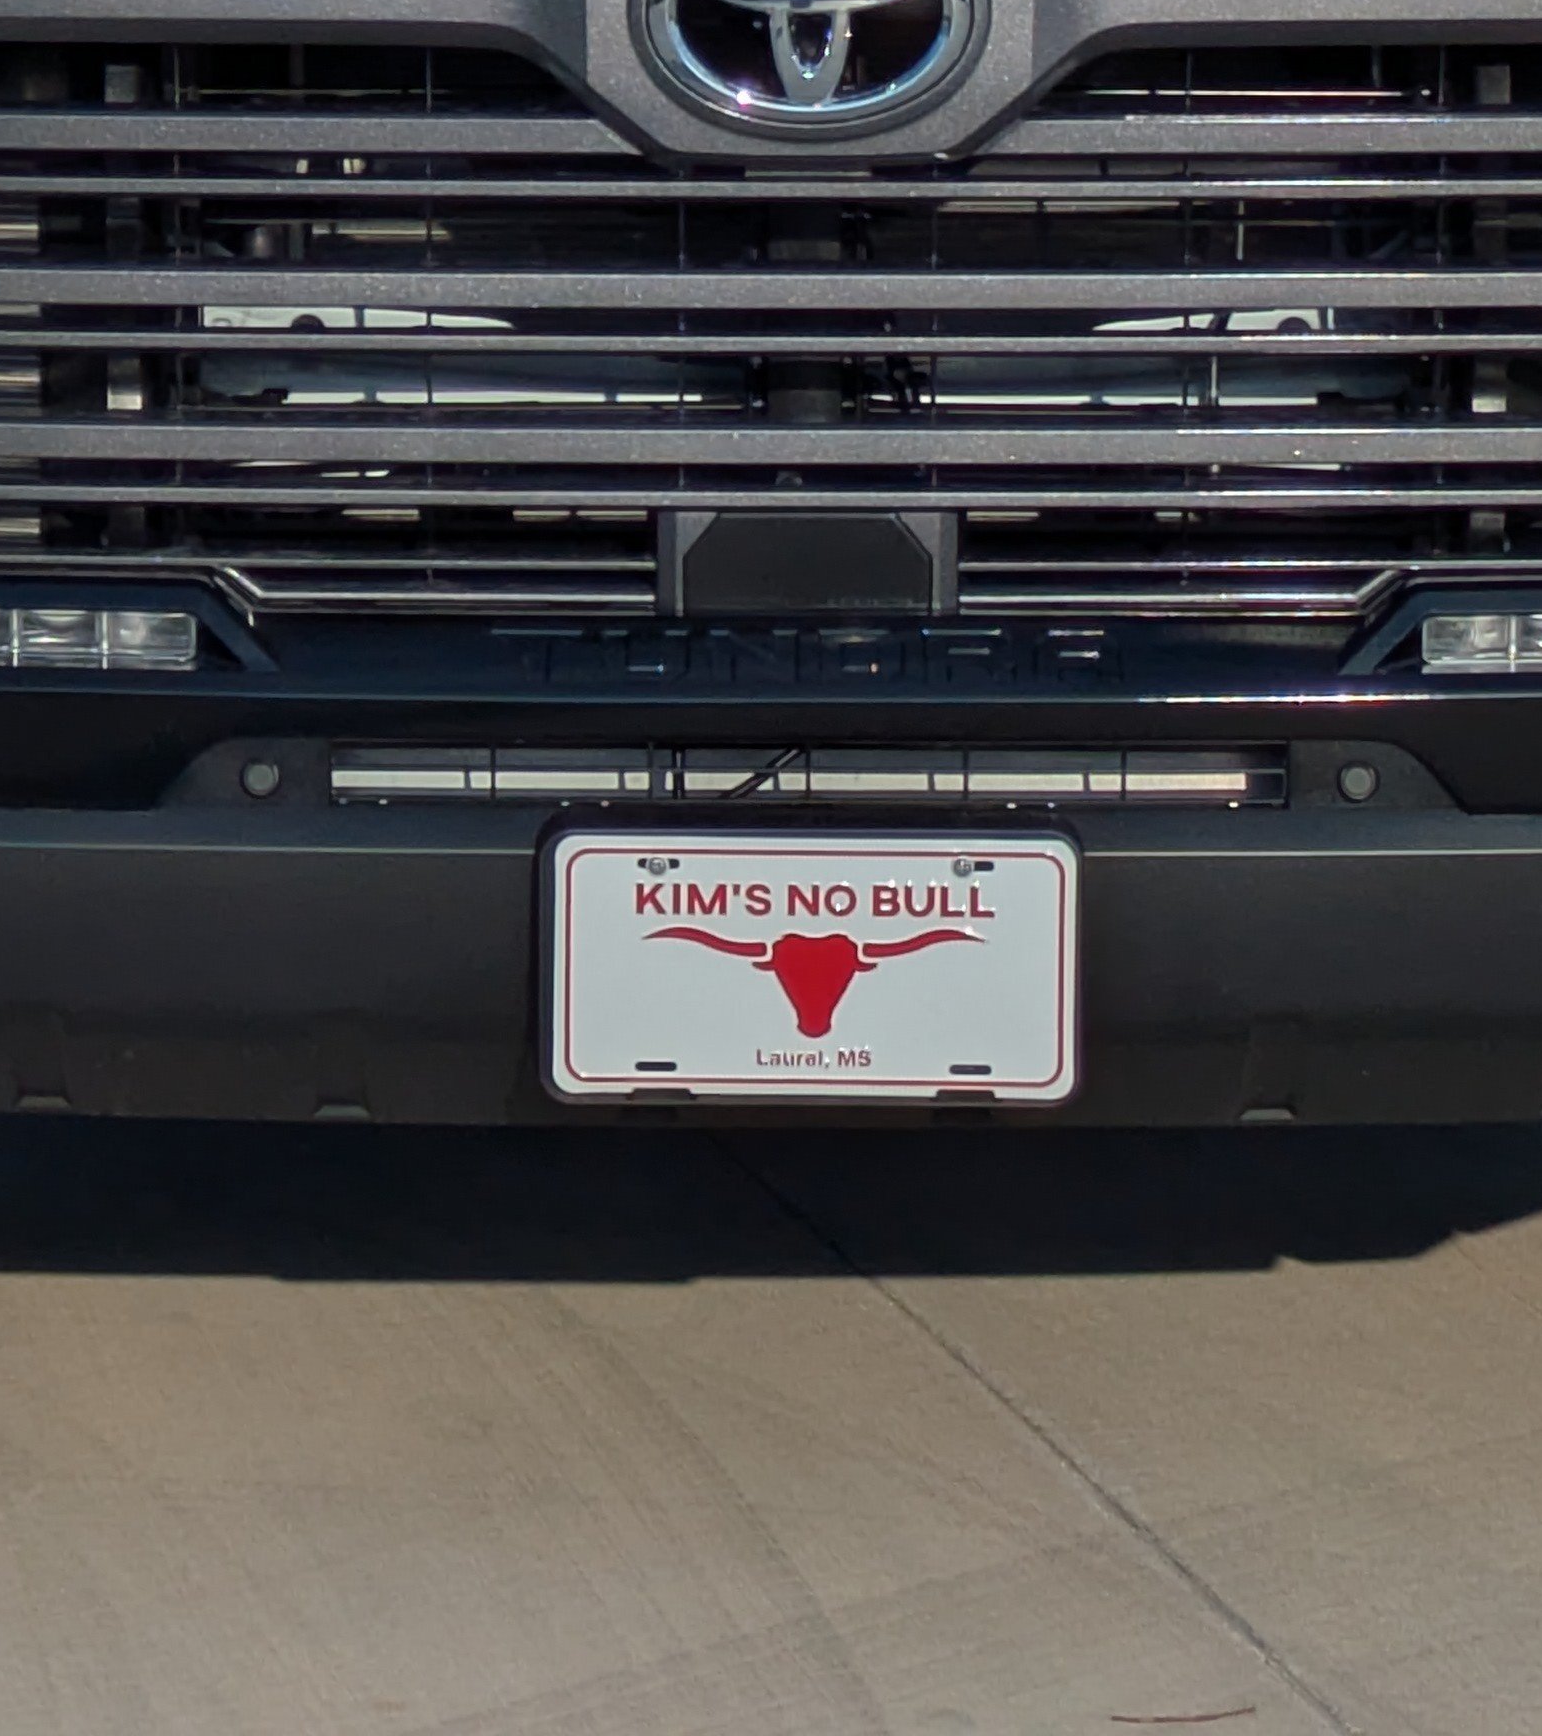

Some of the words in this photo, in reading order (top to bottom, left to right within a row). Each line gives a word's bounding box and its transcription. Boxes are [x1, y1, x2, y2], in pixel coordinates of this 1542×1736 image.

[635, 882, 772, 915] KIM'S
[787, 883, 858, 916] NO
[872, 882, 996, 918] BULL
[838, 1049, 871, 1067] MS
